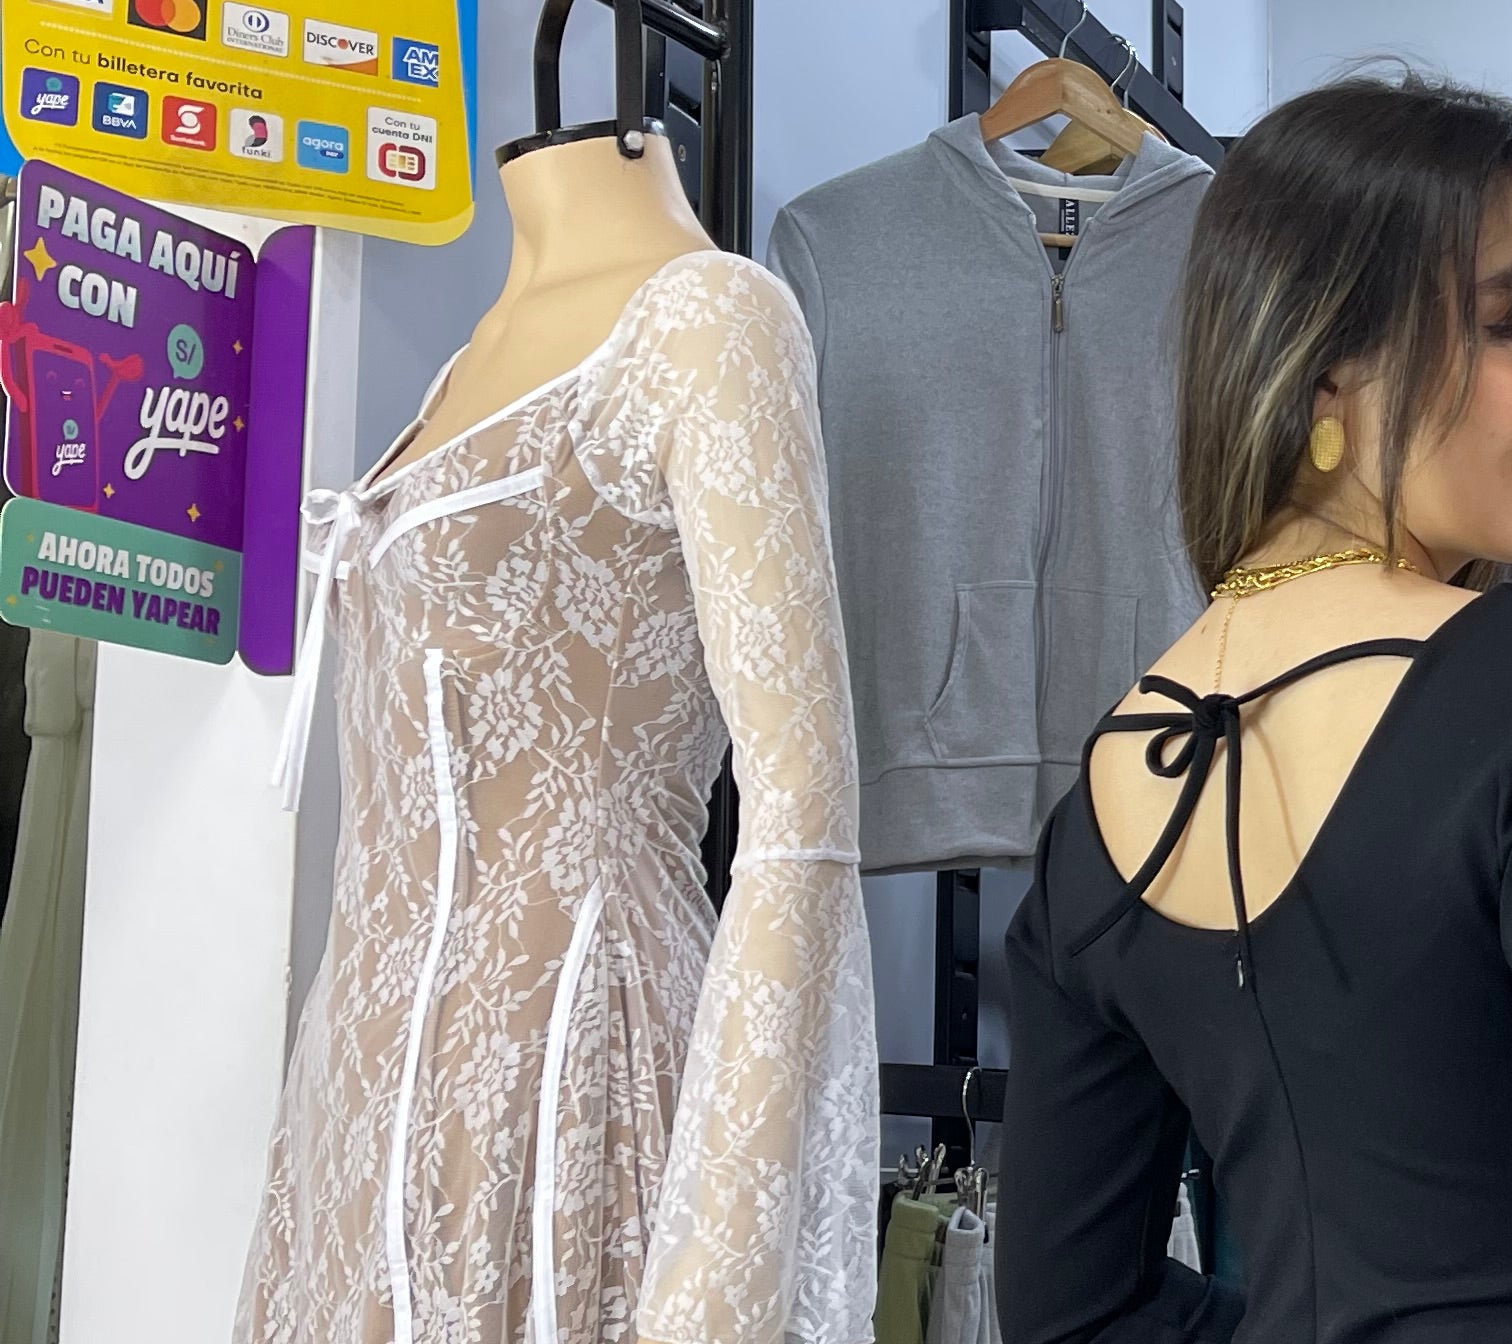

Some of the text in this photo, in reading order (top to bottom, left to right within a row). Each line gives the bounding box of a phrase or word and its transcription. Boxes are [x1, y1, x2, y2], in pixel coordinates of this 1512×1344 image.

[227, 27, 284, 46] Diners Club
[306, 32, 375, 56] DISCOVER
[24, 38, 263, 100] Con tu billetera favorita
[30, 93, 70, 115] yape
[372, 126, 433, 143] cuenta DNI
[384, 116, 421, 130] Con tu
[302, 136, 344, 151] agora
[37, 185, 241, 299] PAGA AQUÍ
[57, 264, 138, 328] CON
[175, 338, 197, 365] S/
[124, 386, 229, 480] yape
[52, 443, 87, 476] yape
[37, 531, 216, 598] AHORA TODOS
[20, 565, 221, 636] PUEDEN YAPEAR
